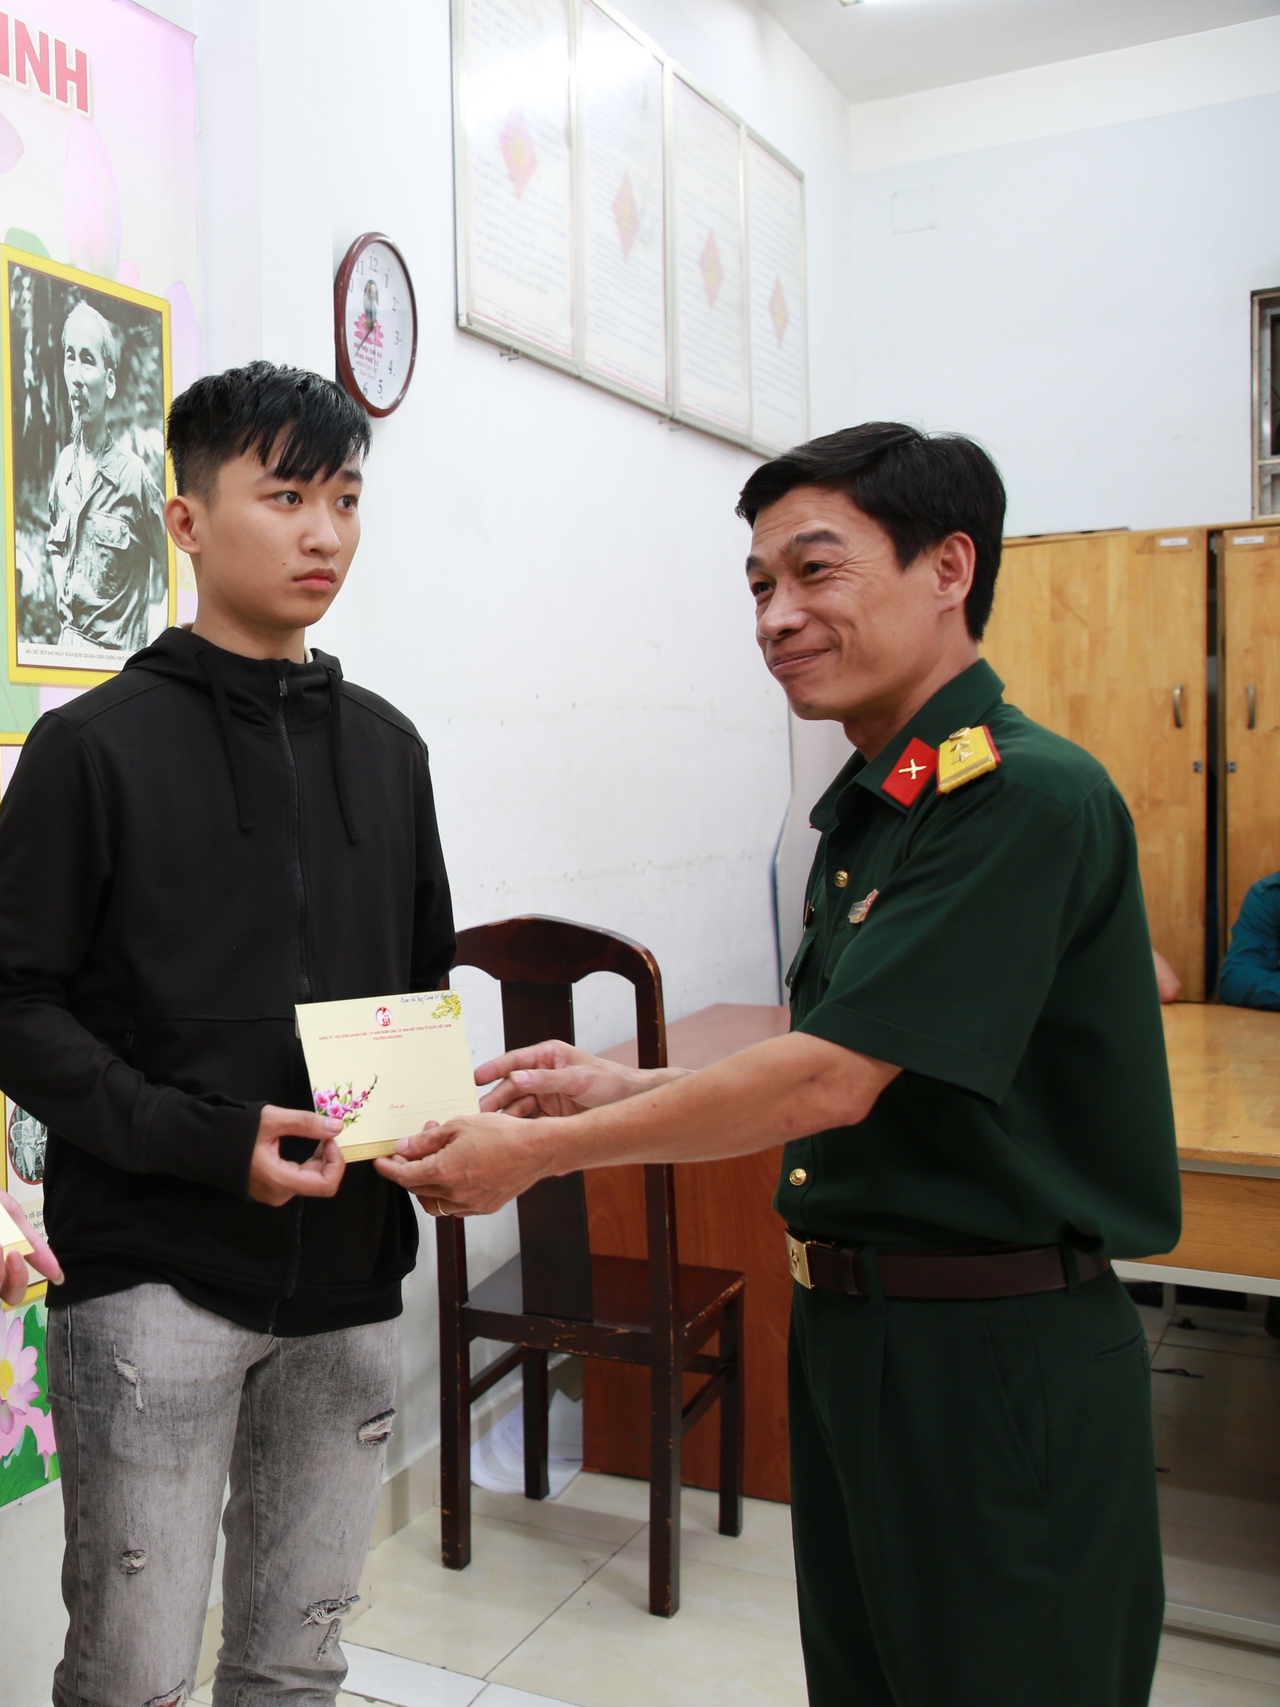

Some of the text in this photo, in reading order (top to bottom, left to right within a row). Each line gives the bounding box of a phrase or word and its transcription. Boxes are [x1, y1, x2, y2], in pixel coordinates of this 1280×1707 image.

[369, 256, 378, 273] 12
[384, 273, 389, 289] 1
[392, 297, 397, 312] 2
[394, 331, 399, 346] 3
[388, 360, 393, 376] 4
[362, 382, 368, 397] 6
[377, 380, 383, 395] 5
